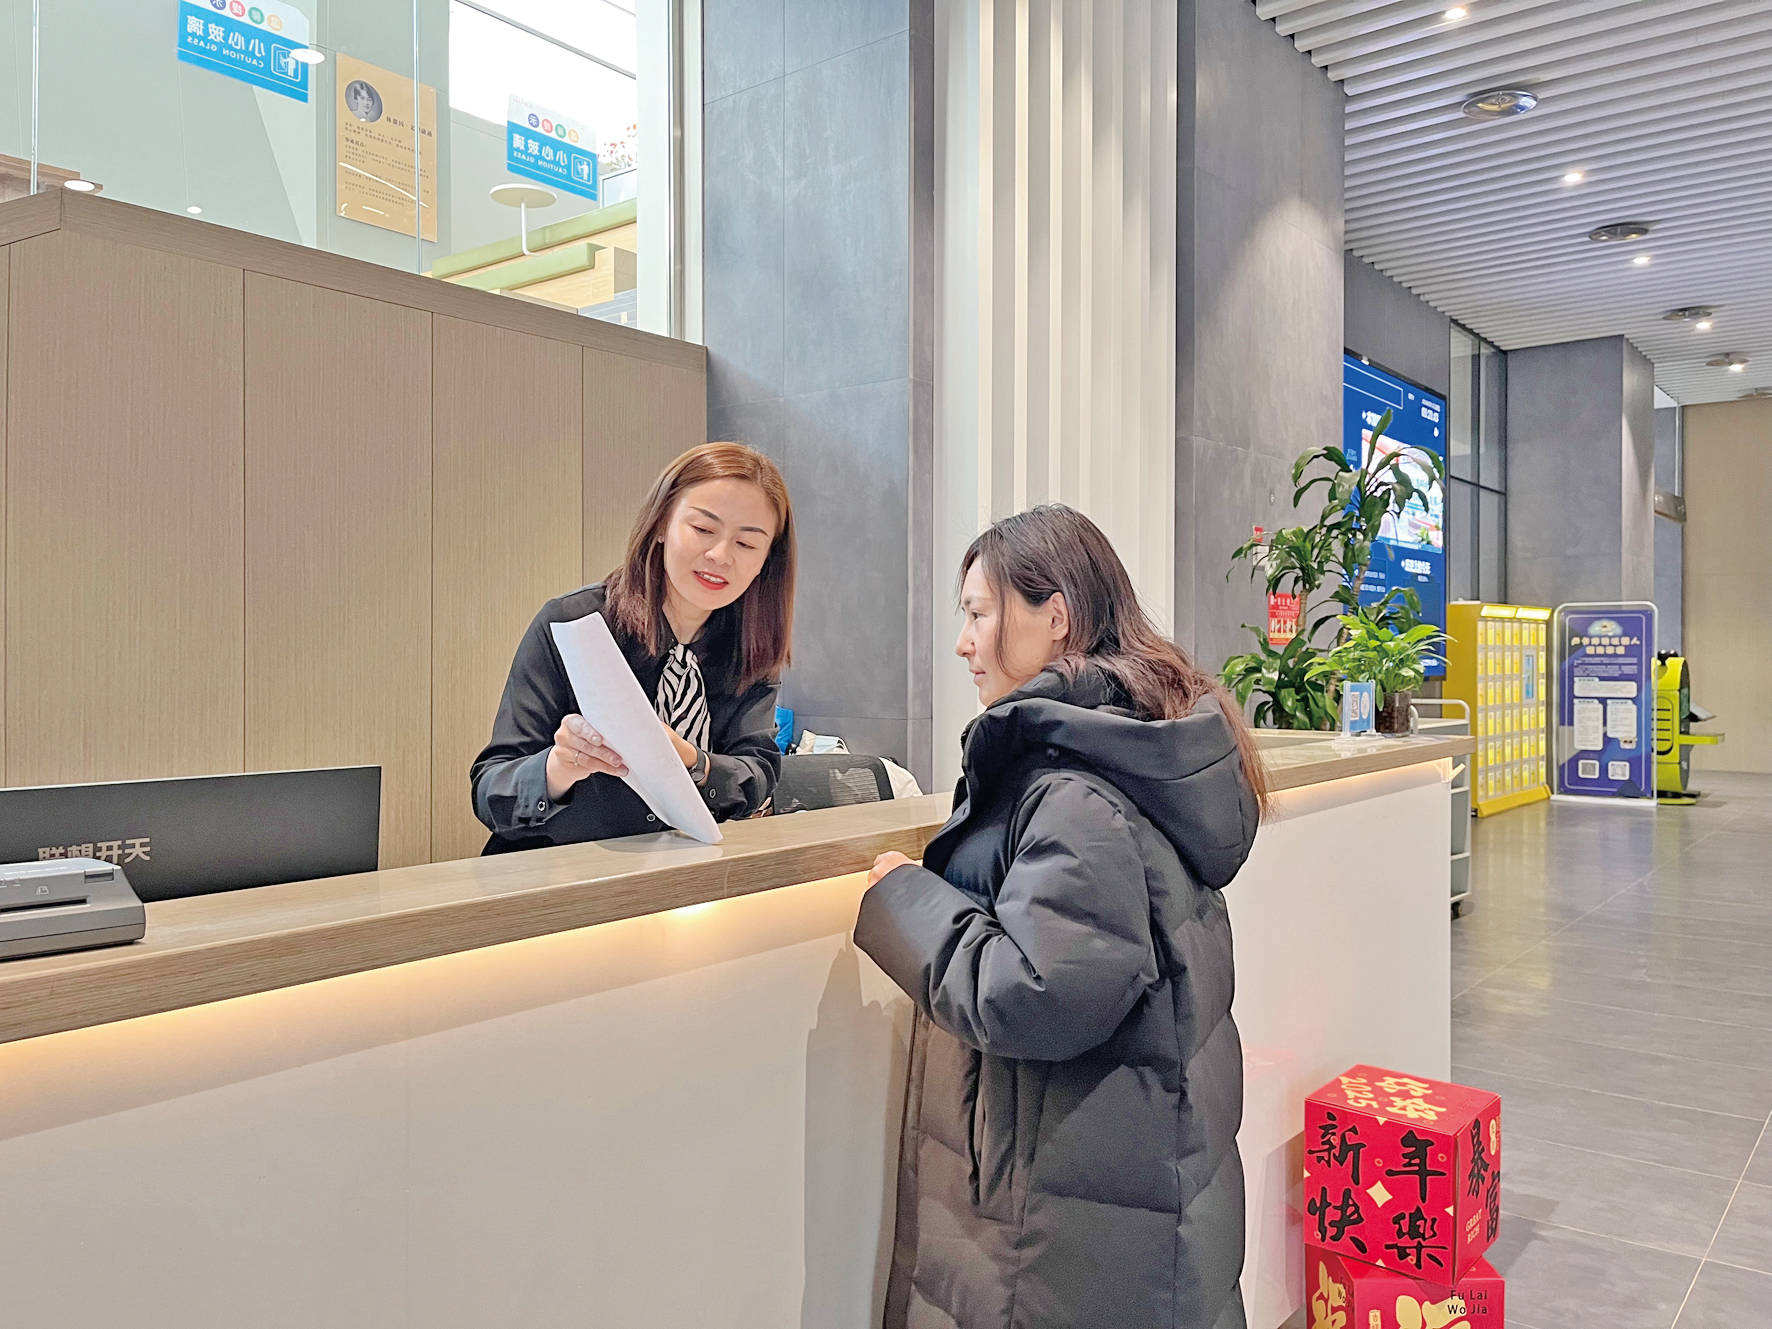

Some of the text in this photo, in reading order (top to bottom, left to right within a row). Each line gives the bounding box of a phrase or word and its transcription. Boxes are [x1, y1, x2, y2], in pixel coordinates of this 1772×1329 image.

[1339, 1076, 1379, 1108] 2025
[1307, 1112, 1447, 1203] 新年
[1450, 1290, 1488, 1301] Fu Lai
[1447, 1304, 1466, 1315] Wo
